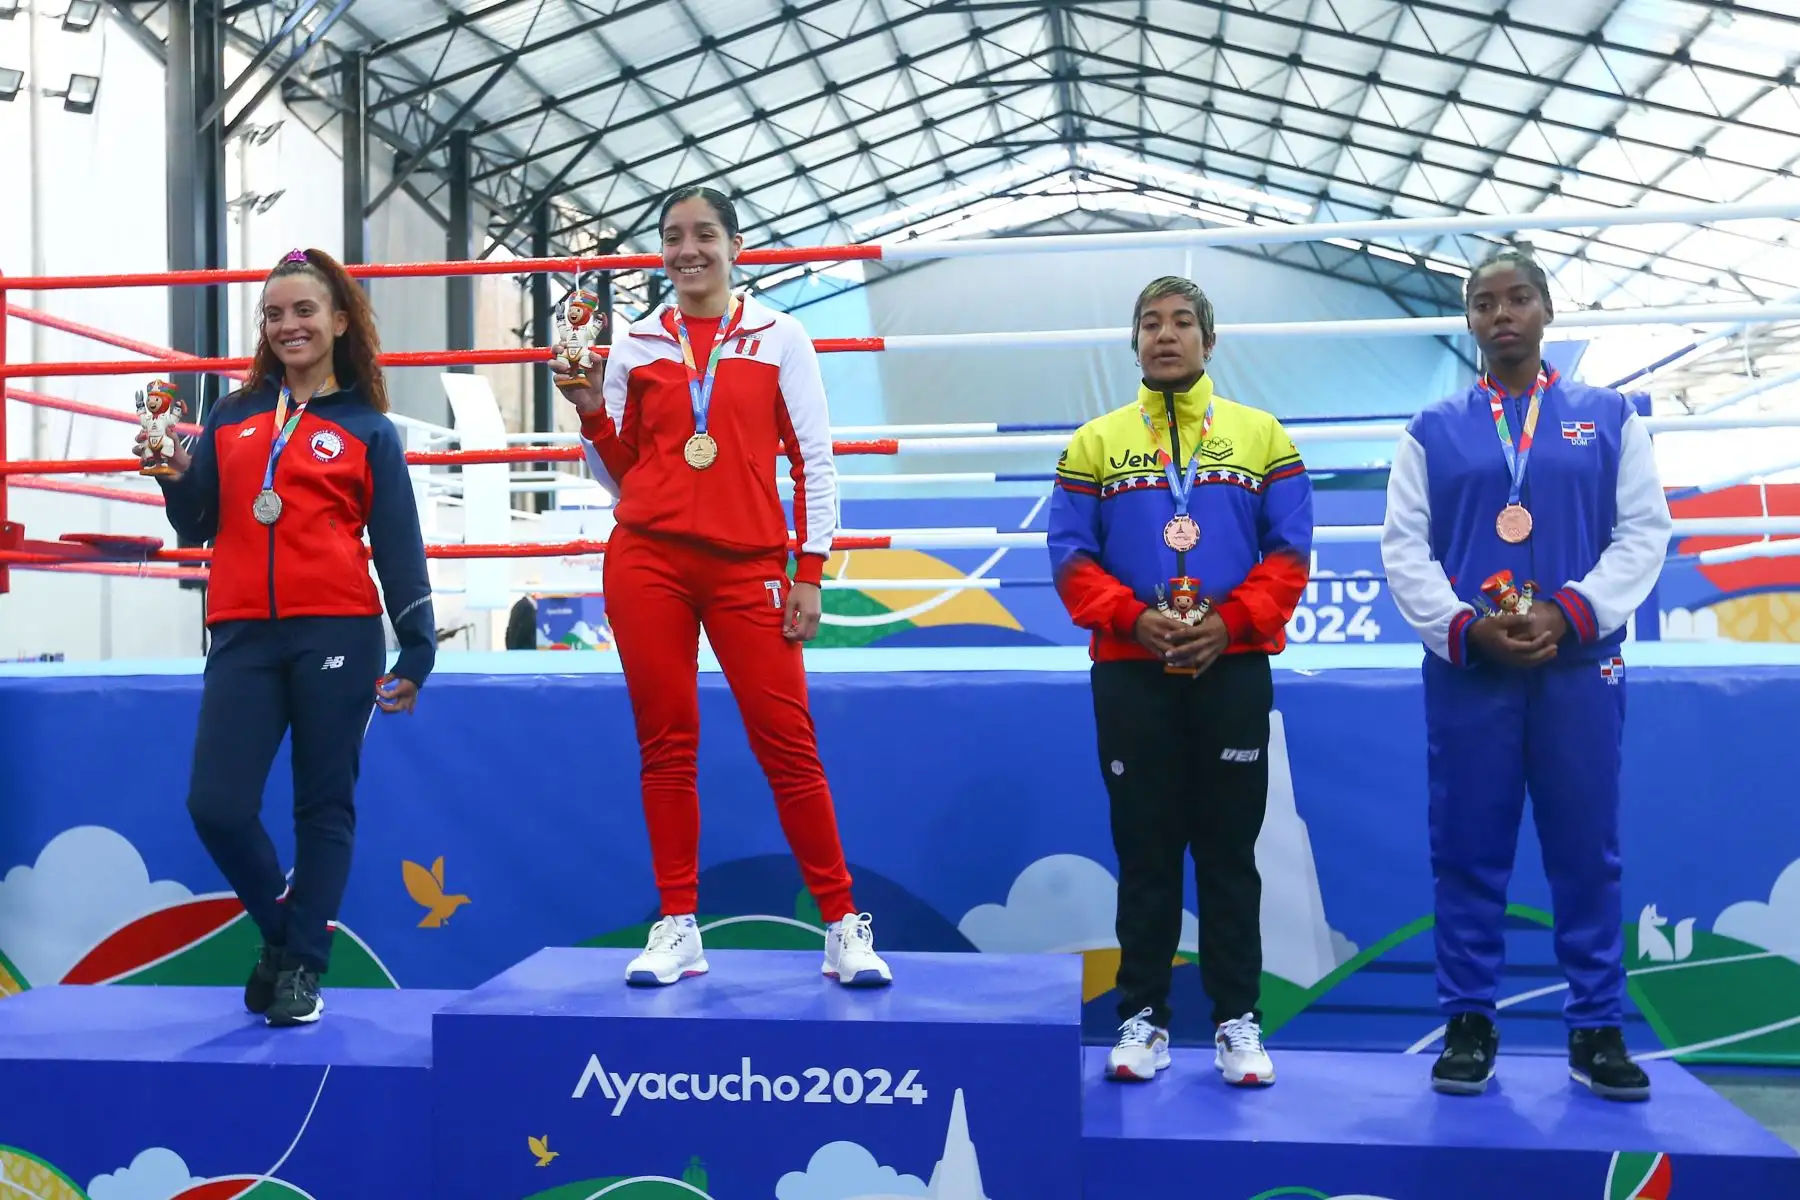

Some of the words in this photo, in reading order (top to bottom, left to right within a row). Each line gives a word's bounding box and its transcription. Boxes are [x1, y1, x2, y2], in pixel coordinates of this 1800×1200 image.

[1571, 438, 1588, 446] DOM
[1299, 549, 1380, 603] ho
[1284, 605, 1380, 643] 024
